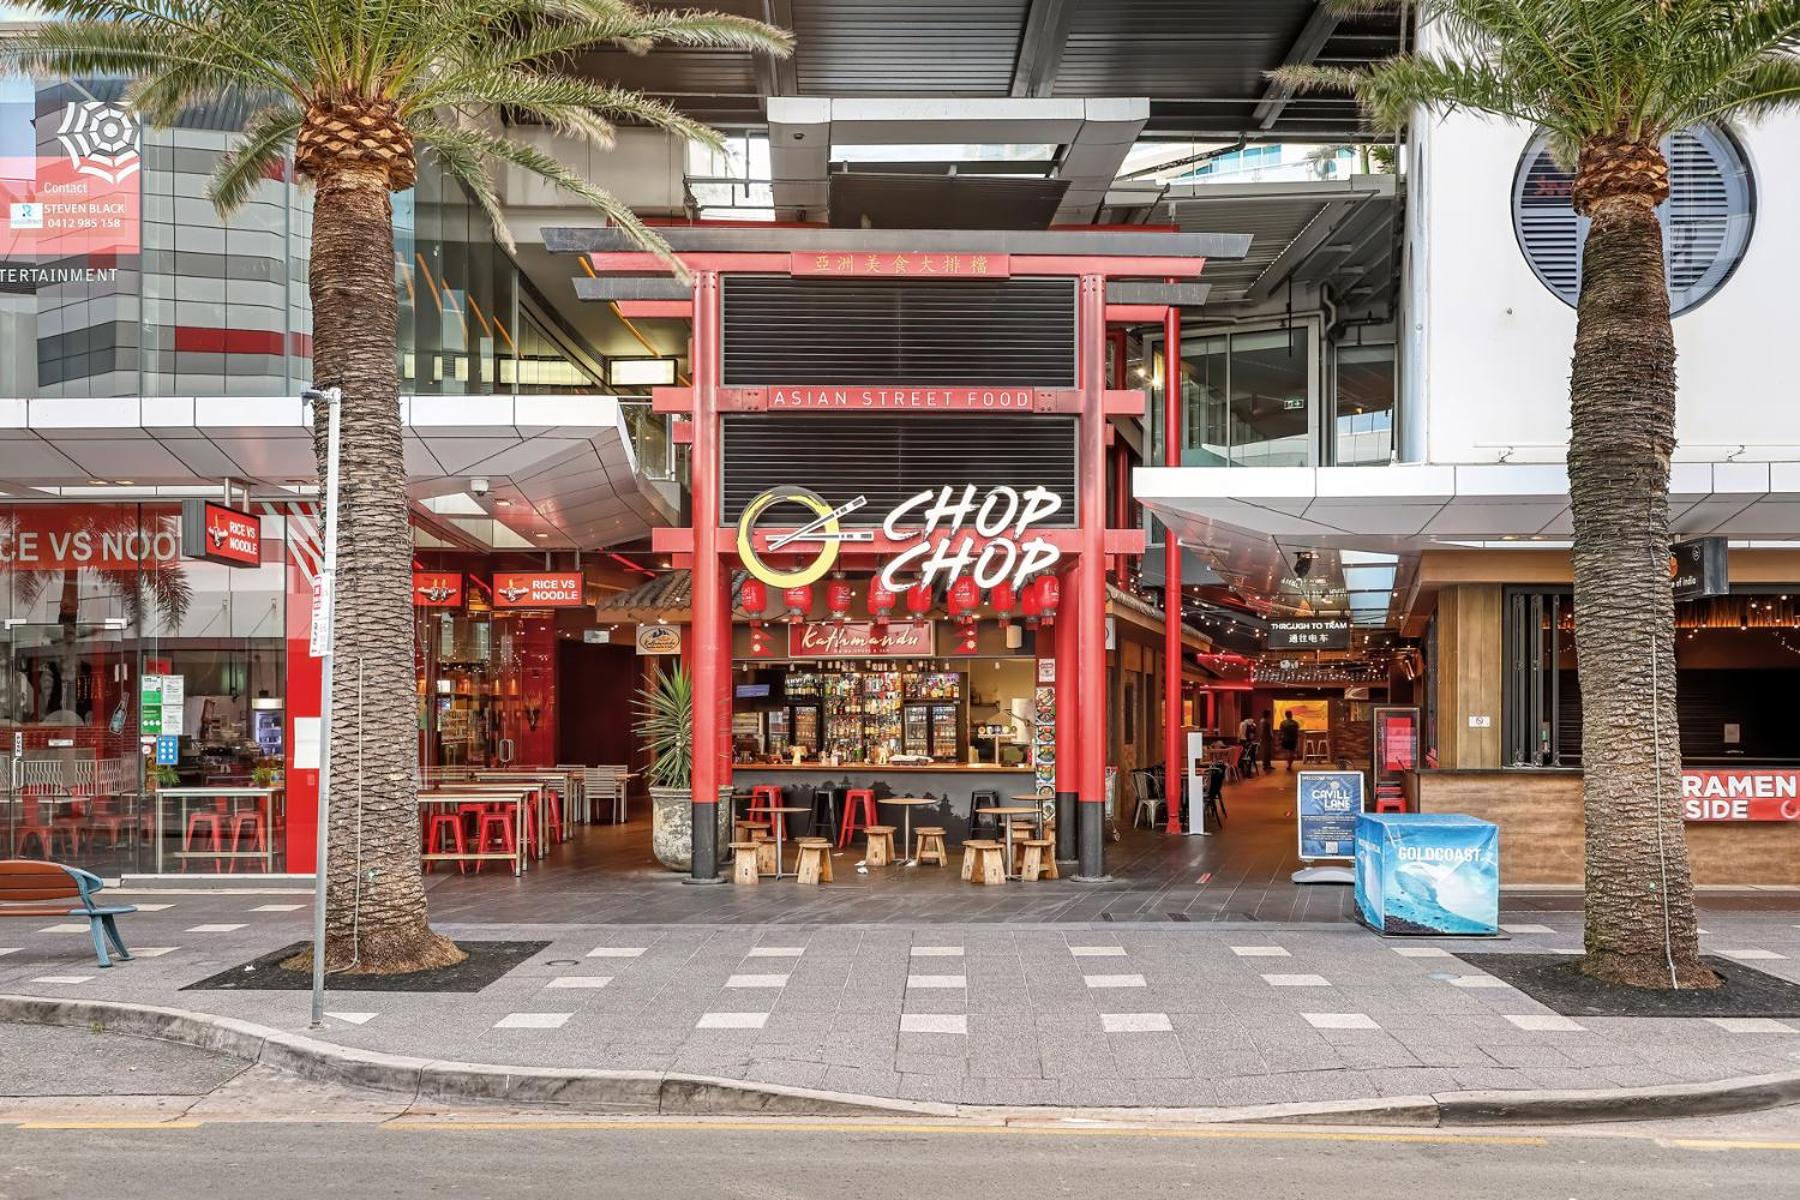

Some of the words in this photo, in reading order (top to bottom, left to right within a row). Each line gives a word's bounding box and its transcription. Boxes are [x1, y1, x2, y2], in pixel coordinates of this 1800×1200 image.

[43, 182, 87, 193] Contact
[44, 204, 87, 214] STEVEN
[89, 204, 125, 214] BLACK
[47, 219, 76, 228] 0412
[77, 219, 98, 228] 985
[101, 218, 121, 228] 158
[774, 391, 847, 406] ASIAN
[862, 392, 952, 406] STREET
[967, 392, 1028, 407] FOOD
[883, 484, 1062, 541] CHOP
[229, 520, 246, 537] RICE
[49, 531, 92, 561] VS
[102, 530, 185, 561] NOO
[229, 537, 258, 555] NOODLE
[881, 536, 1061, 593] CHOP
[532, 580, 558, 589] RICE
[561, 580, 576, 589] VS
[532, 591, 578, 600] NOODLE
[801, 624, 919, 653] Kathmandu
[1312, 790, 1350, 799] CAVILL
[1681, 775, 1797, 798] RAMEN
[1324, 799, 1350, 809] LANE
[1684, 800, 1748, 819] SIDE
